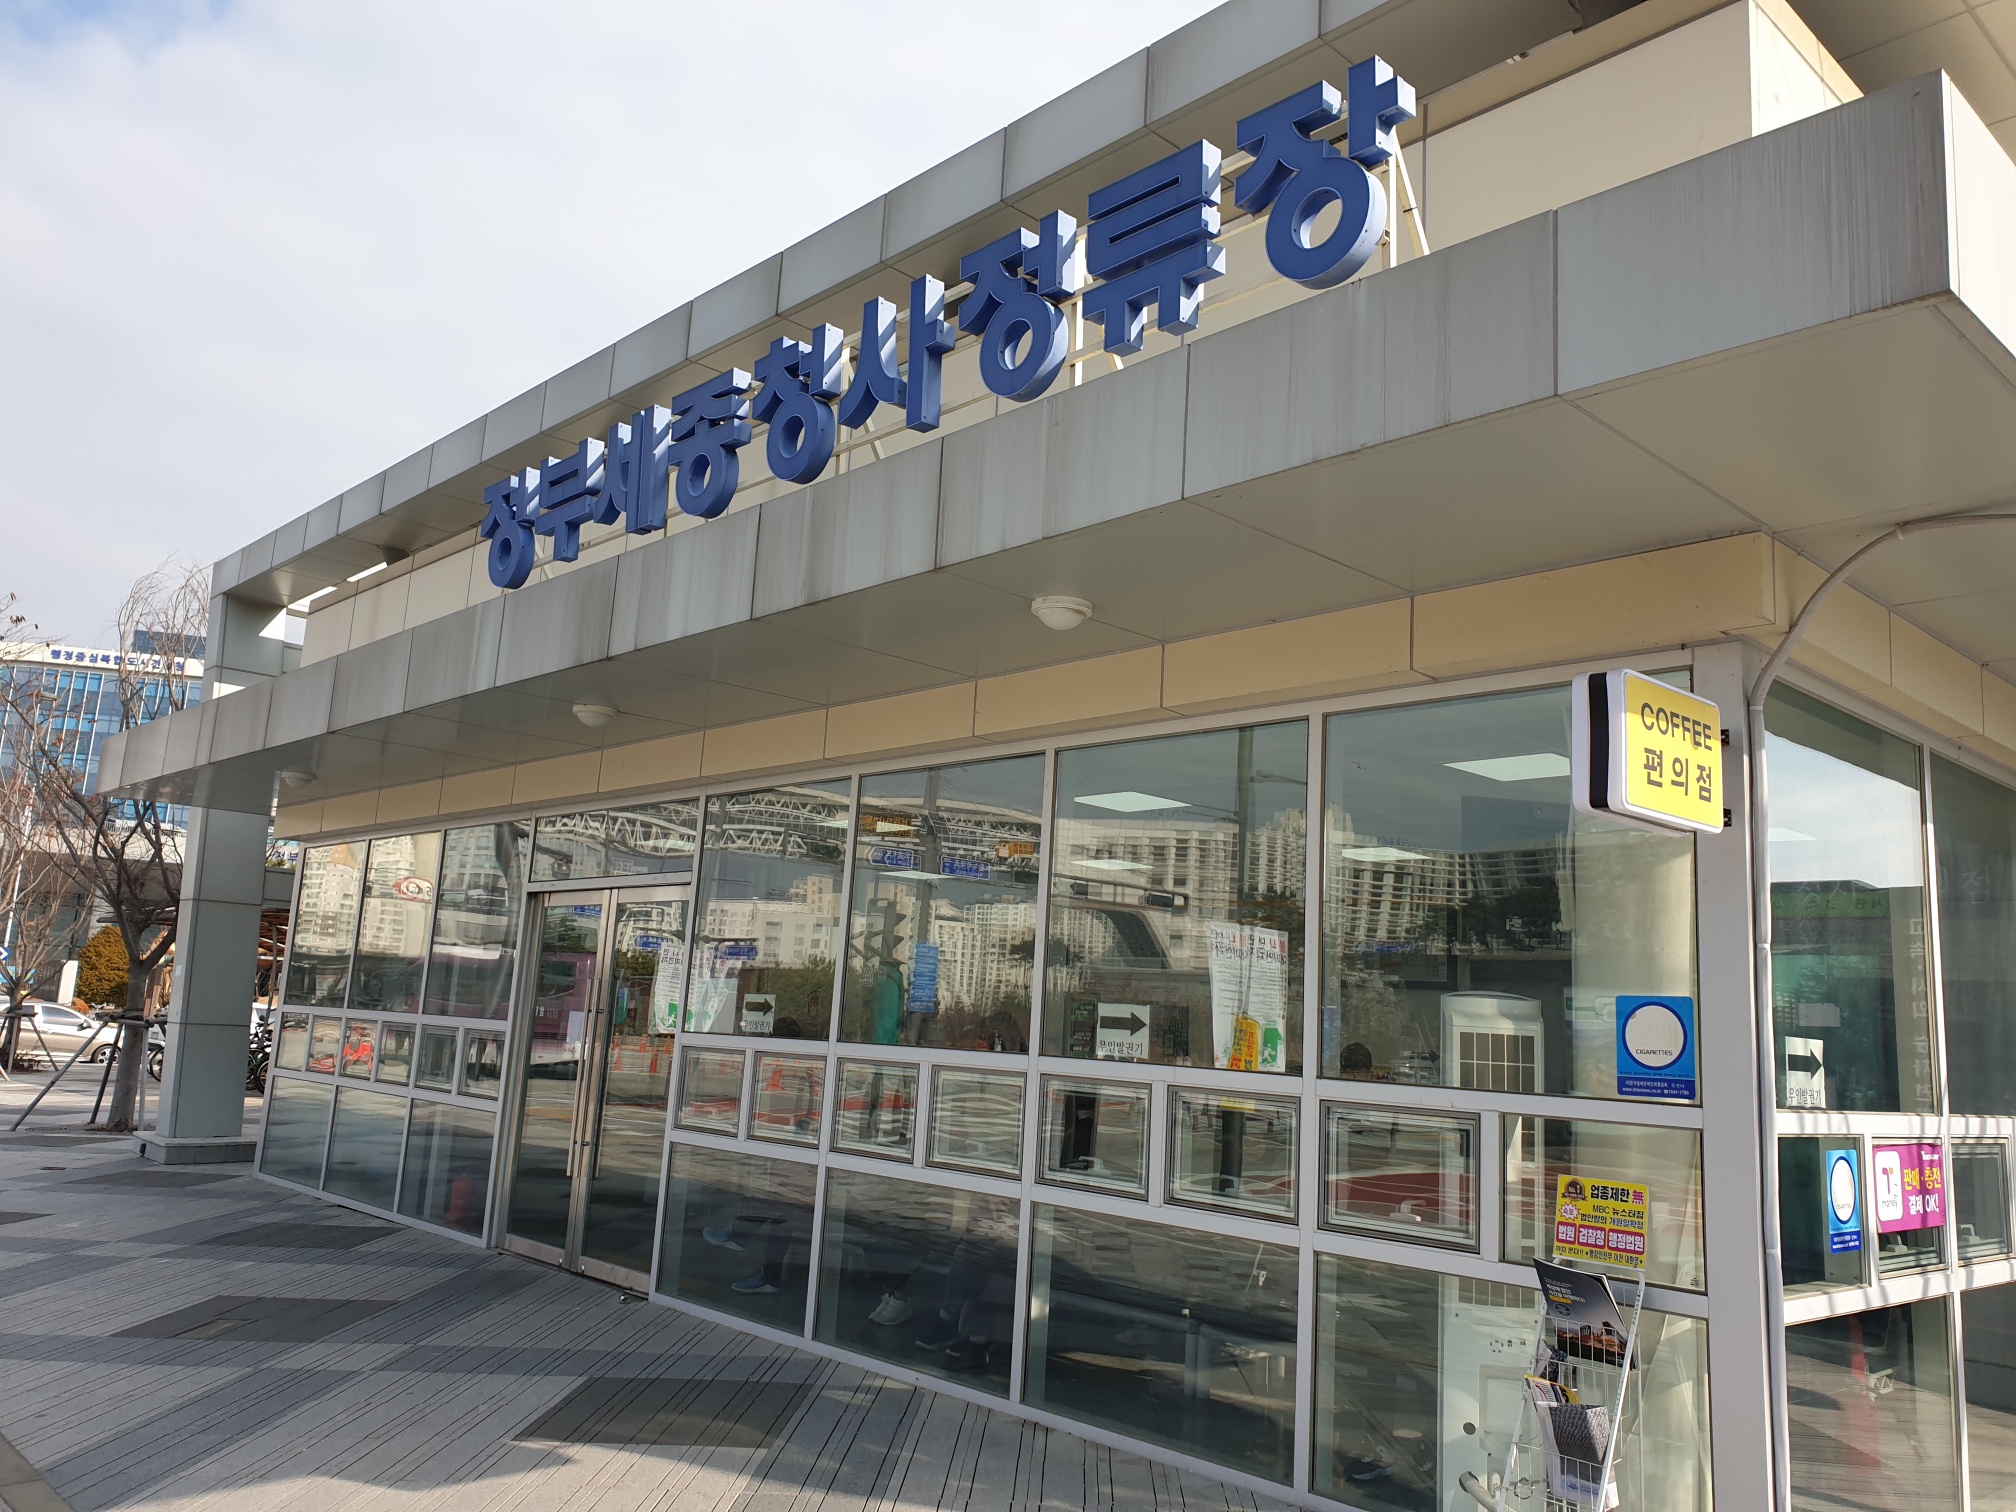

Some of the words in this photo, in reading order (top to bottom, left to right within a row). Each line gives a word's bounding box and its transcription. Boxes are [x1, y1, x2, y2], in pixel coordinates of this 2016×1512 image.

[50, 649, 184, 672] 행정중심복합도시건청
[1640, 702, 1713, 752] COFFEE
[1643, 747, 1712, 803] 편의점
[1098, 1040, 1144, 1057] 무인발권기
[1635, 1048, 1673, 1056] CIGARETTES
[1788, 1087, 1822, 1106] 무인발권기
[1590, 1184, 1630, 1203] 업종제한
[1632, 1189, 1645, 1205] 無
[1908, 1195, 1924, 1215] 결제
[1925, 1193, 1940, 1213] OK!
[1593, 1204, 1610, 1214] MBC
[1558, 1224, 1575, 1241] 법원
[1579, 1227, 1605, 1246] 검찰청
[1608, 1231, 1644, 1252] 행정법원
